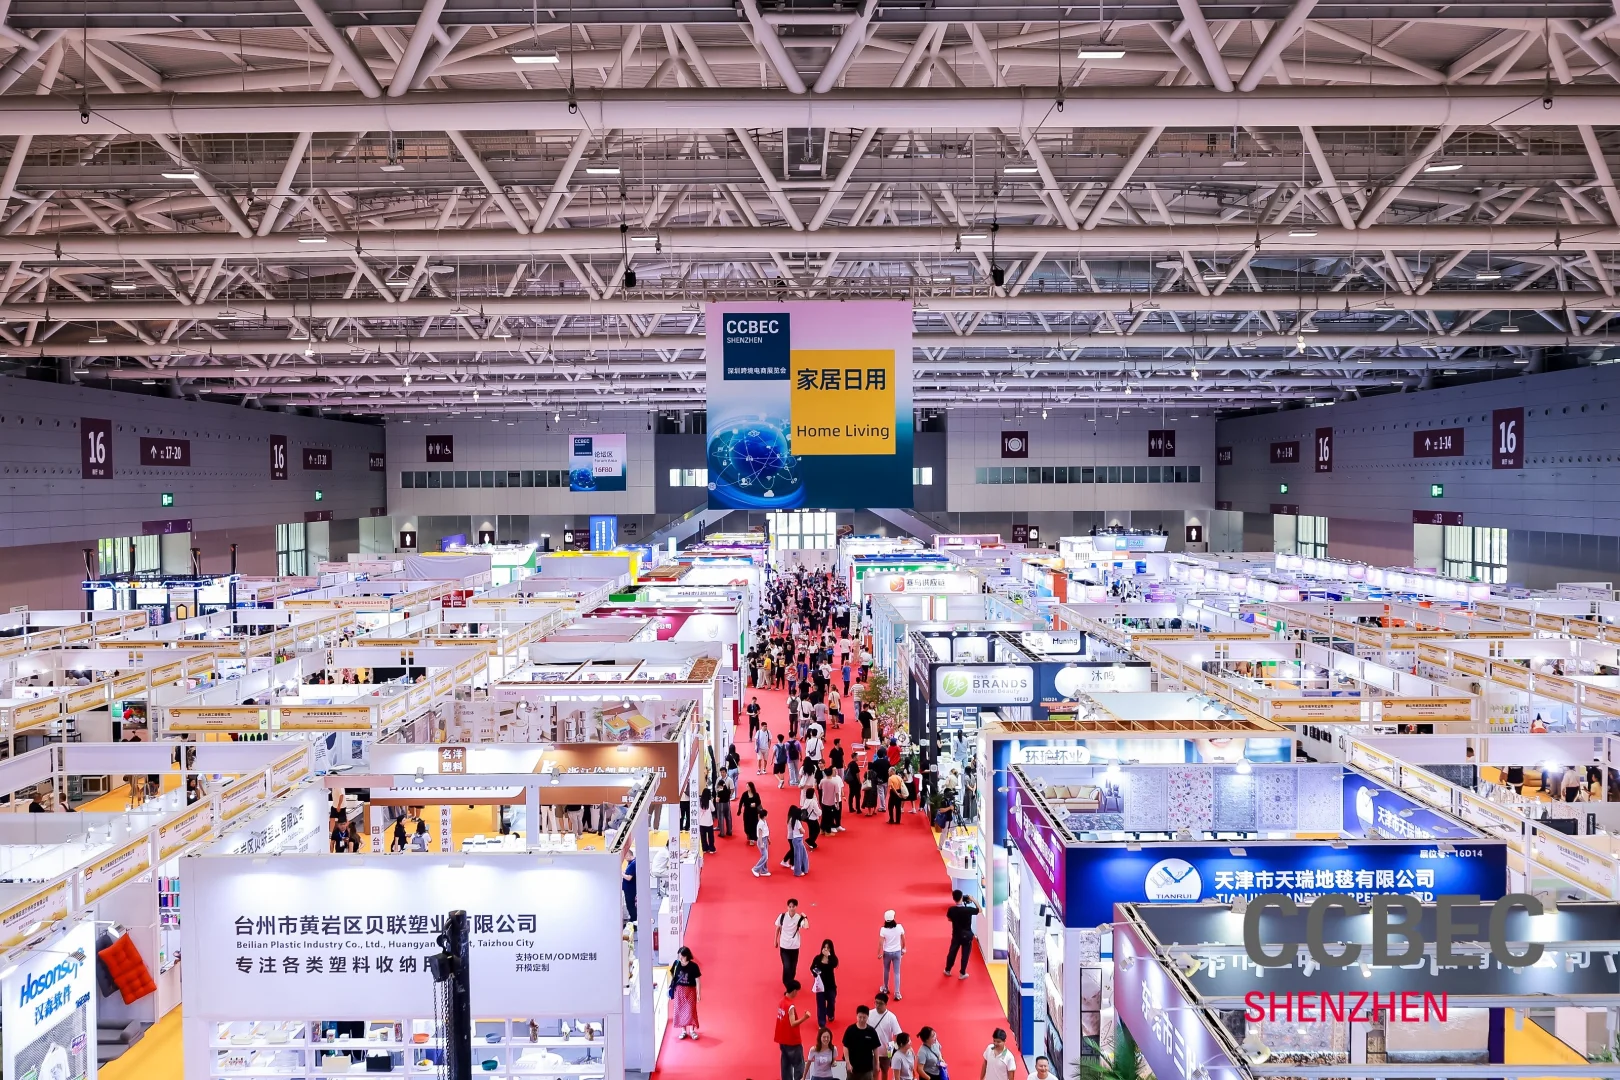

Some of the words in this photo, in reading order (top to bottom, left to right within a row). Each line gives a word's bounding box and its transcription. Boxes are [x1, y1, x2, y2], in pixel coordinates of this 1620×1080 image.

[726, 320, 779, 334] CCBEC
[796, 368, 886, 391] 家居日用
[797, 425, 841, 437] Home
[845, 424, 890, 440] Living
[1499, 420, 1517, 454] 16
[88, 431, 106, 464] 16
[1318, 436, 1330, 462] 16
[1439, 435, 1452, 450] 1-14
[165, 446, 182, 460] 17-20
[273, 444, 285, 469] 16
[972, 679, 1027, 689] BRANDS
[442, 749, 463, 760] 名洋
[442, 761, 463, 772] 塑料
[1214, 868, 1435, 890] 天津市天瑞地毯有限公司
[669, 850, 679, 935] 浙江伶凯塑料制品
[236, 941, 268, 949] Beilian
[270, 940, 301, 949] Plastic
[303, 940, 343, 951] Industry
[345, 940, 363, 949] Co.,
[365, 940, 386, 949] Ltd.,
[388, 939, 436, 951] Huangyan
[478, 938, 514, 947] Taizhou
[516, 938, 535, 949] City
[515, 952, 598, 962] 支持OEM/ODM定制
[515, 963, 550, 972] 开模定制
[34, 984, 72, 1026] 汉森软件
